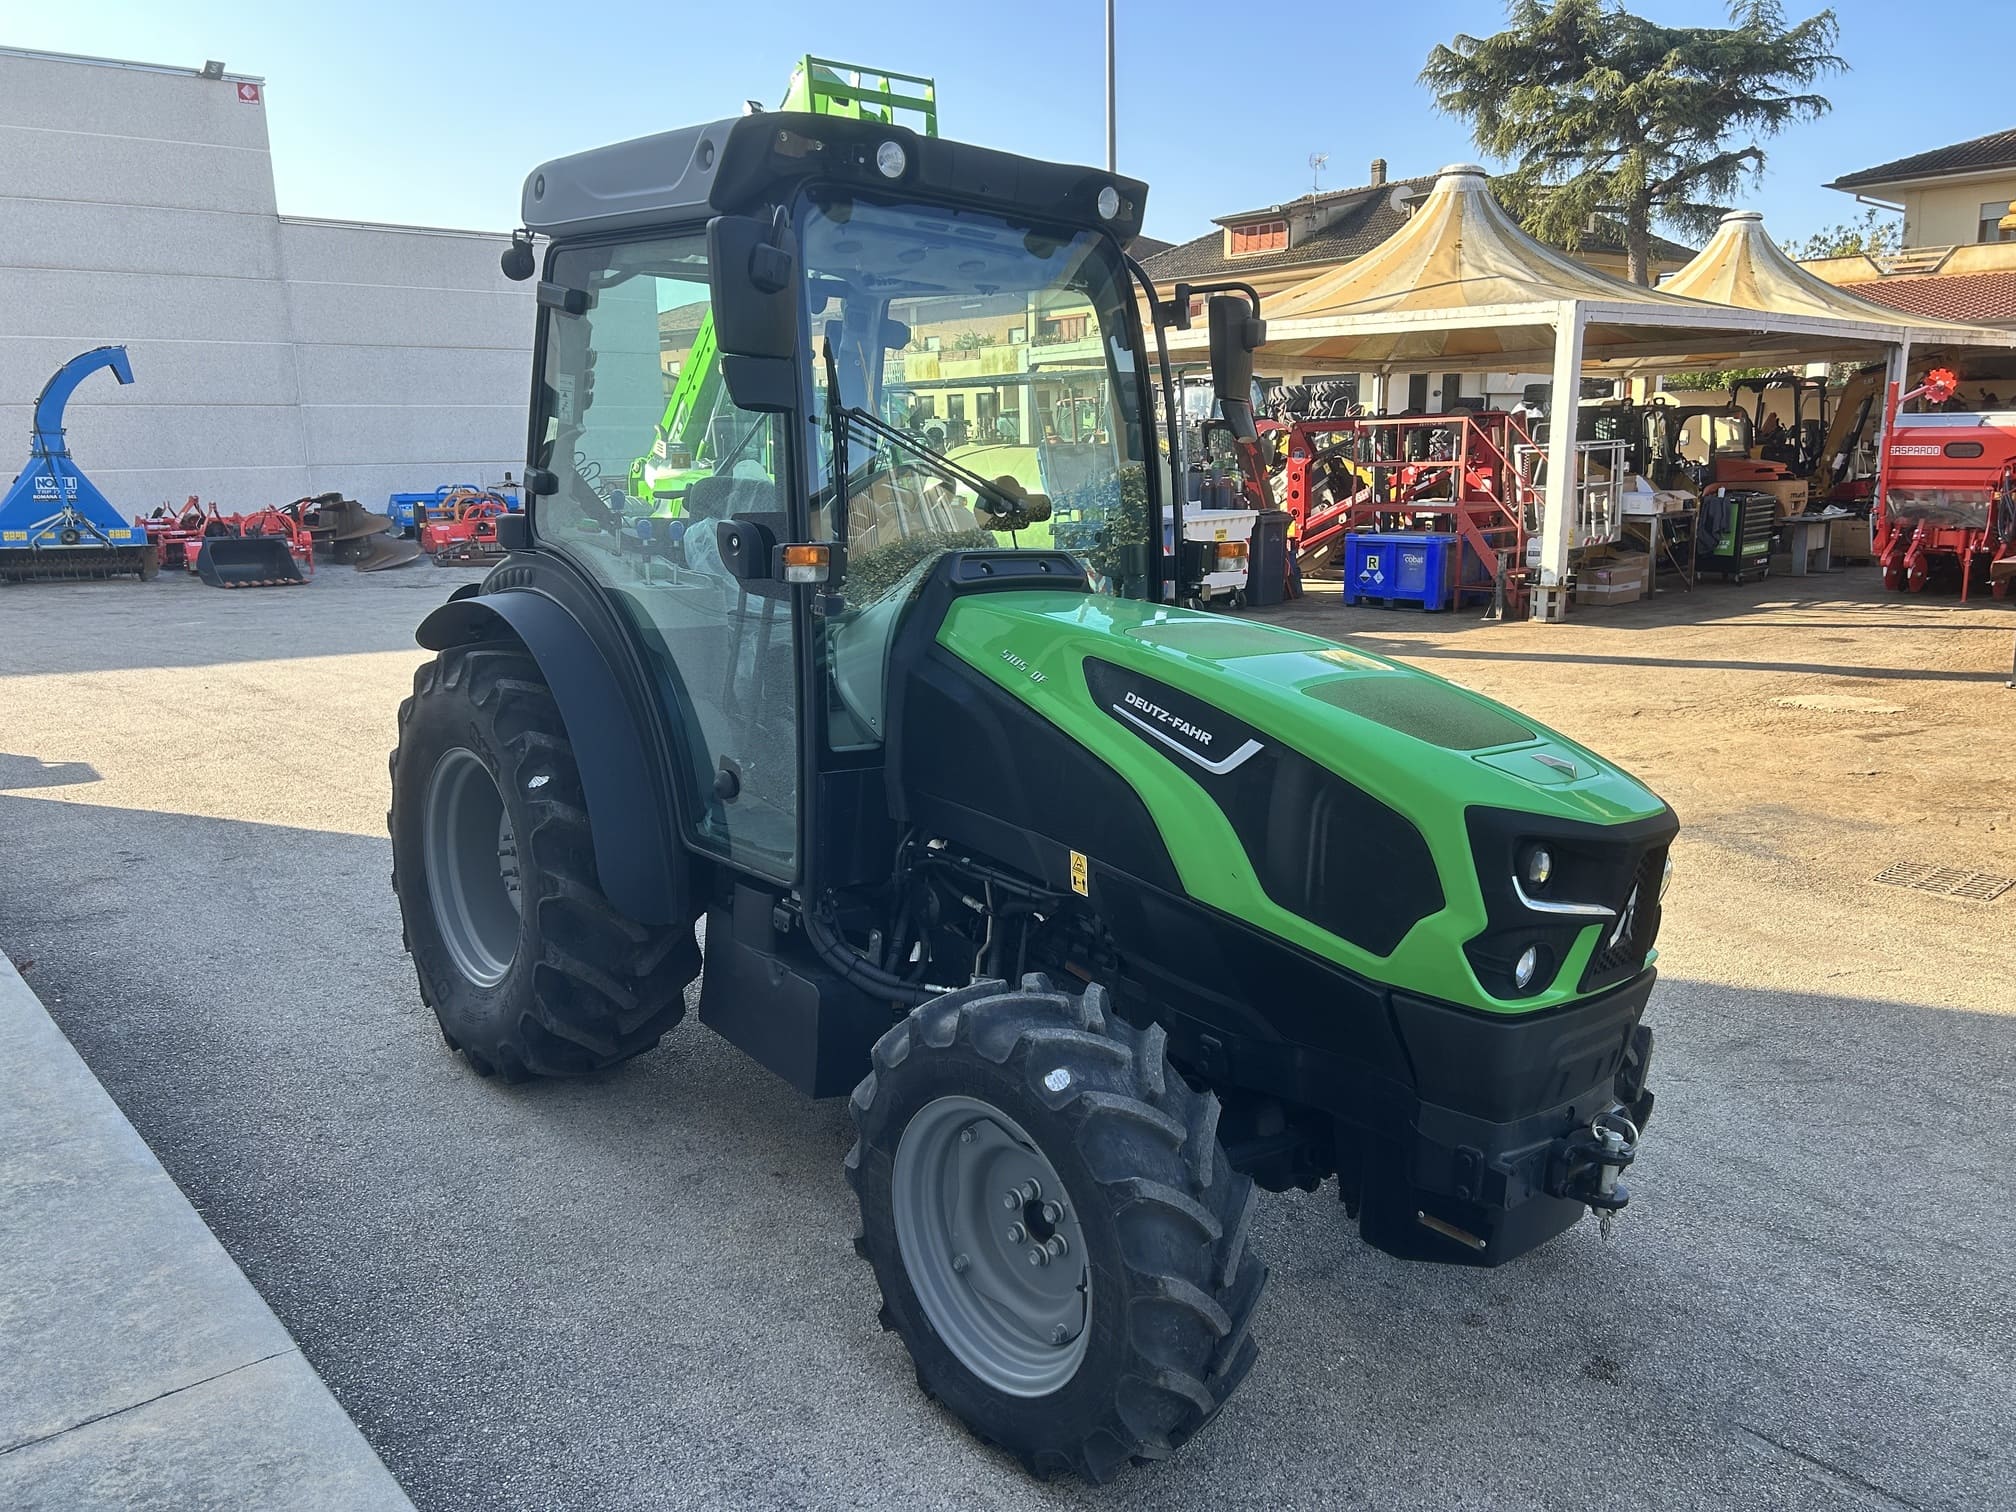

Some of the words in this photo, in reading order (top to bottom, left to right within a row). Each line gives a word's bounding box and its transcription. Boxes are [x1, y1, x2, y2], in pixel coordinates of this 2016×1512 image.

[1889, 446, 1940, 455] GASPARDO
[36, 478, 76, 489] NOLI
[1368, 557, 1377, 569] R
[1404, 555, 1424, 564] cobat
[1000, 648, 1028, 671] 5105
[1124, 691, 1213, 745] DEUTZ-FAHR
